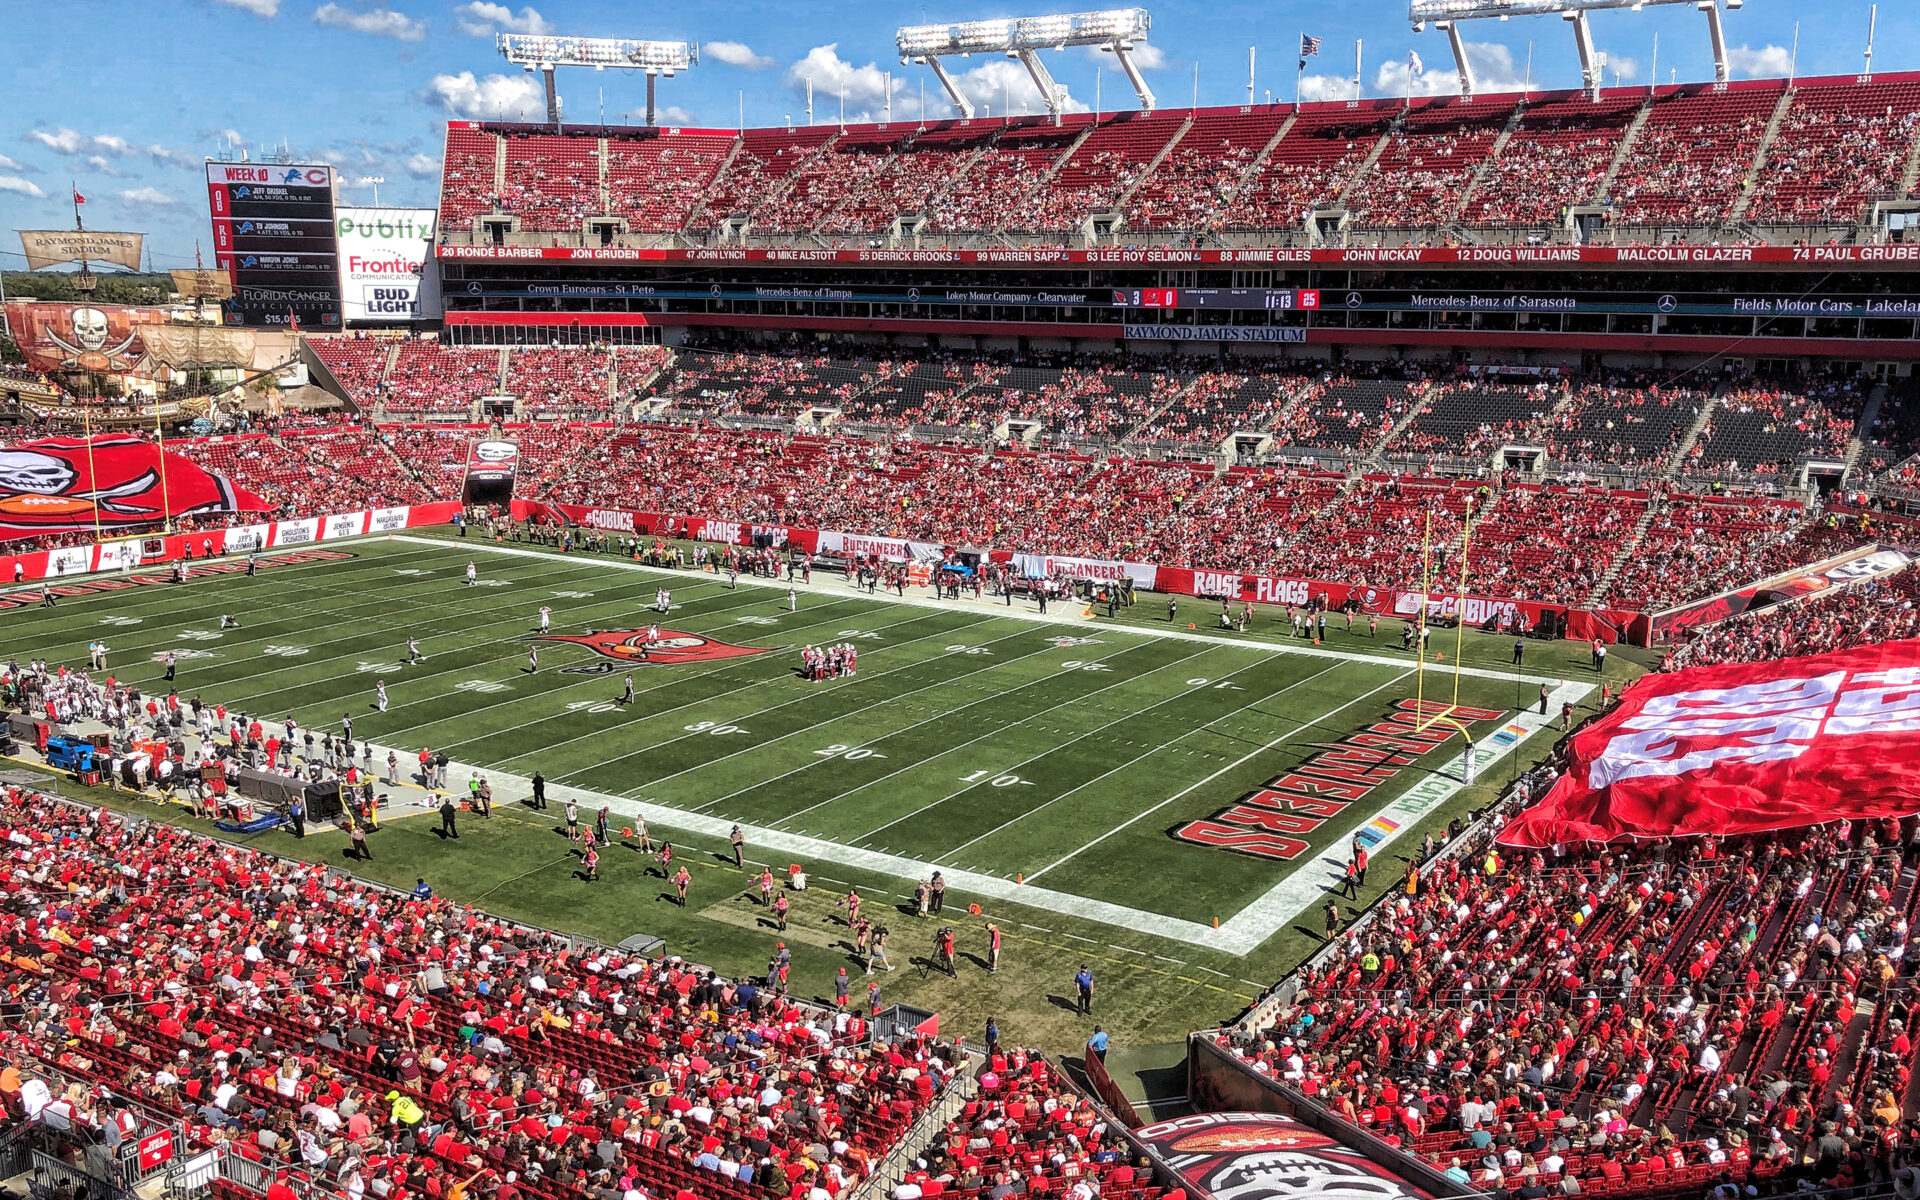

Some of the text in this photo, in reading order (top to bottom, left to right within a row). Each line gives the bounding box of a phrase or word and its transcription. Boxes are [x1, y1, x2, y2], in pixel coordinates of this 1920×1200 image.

[1713, 83, 1728, 91] 332
[1460, 95, 1473, 103] 334
[225, 168, 268, 182] WEEK 10
[338, 217, 428, 239] Publix
[36, 237, 133, 248] RAYMOND JAMES
[61, 246, 110, 254] STADIUM
[442, 249, 454, 257] 20
[498, 249, 542, 258] BARBER
[571, 249, 639, 259] JON GRUDEN
[686, 250, 746, 259] 47 JOHN LYNCH
[766, 250, 837, 260] 40 MIKE ALSTOTT
[1086, 251, 1192, 261] 63 LEE ROY SELMON
[1220, 250, 1311, 261] 88 JIMMIE GILES
[1342, 250, 1377, 261] JOHN
[1456, 249, 1581, 261] 12 DOUG WILLIAMS
[1617, 249, 1752, 261] MALCOLM GLAZER
[1793, 248, 1920, 260] 74 PAUL GRUBE
[860, 252, 952, 261] 55 DERRICK BROOKS
[977, 252, 1060, 261] 99 WARREN SAPP
[349, 256, 427, 273] Frontier
[374, 288, 410, 300] BUD
[528, 284, 655, 295] Crown Eurocars St. Pete
[755, 287, 852, 298] Mercedes-Benz of Tampa
[946, 291, 1086, 303] Lokey Motor Company Clearwater
[1133, 291, 1140, 305] 3
[1165, 292, 1173, 306] 0
[1265, 295, 1291, 309] 11:13
[1303, 293, 1316, 306] 25
[1411, 295, 1576, 308] Mercedes-Benz of Sarasota
[367, 301, 417, 313] LIGHT
[1733, 298, 1771, 311] Fields
[1775, 299, 1816, 311] Motor
[1820, 300, 1852, 312] Cars
[1125, 326, 1305, 342] RAYMOND JAMES STADIUM
[585, 509, 634, 531] #GOBUCS
[706, 520, 742, 543] RAISE
[144, 540, 161, 554] 25
[1046, 557, 1125, 580] BUCCANEERS
[1193, 571, 1309, 606] RAISE THE FLAGS
[1427, 596, 1516, 626] #GOBUCS
[684, 720, 740, 736] 30
[813, 743, 873, 760] 20
[958, 769, 1020, 788] 10
[1137, 1112, 1295, 1139] GEICO
